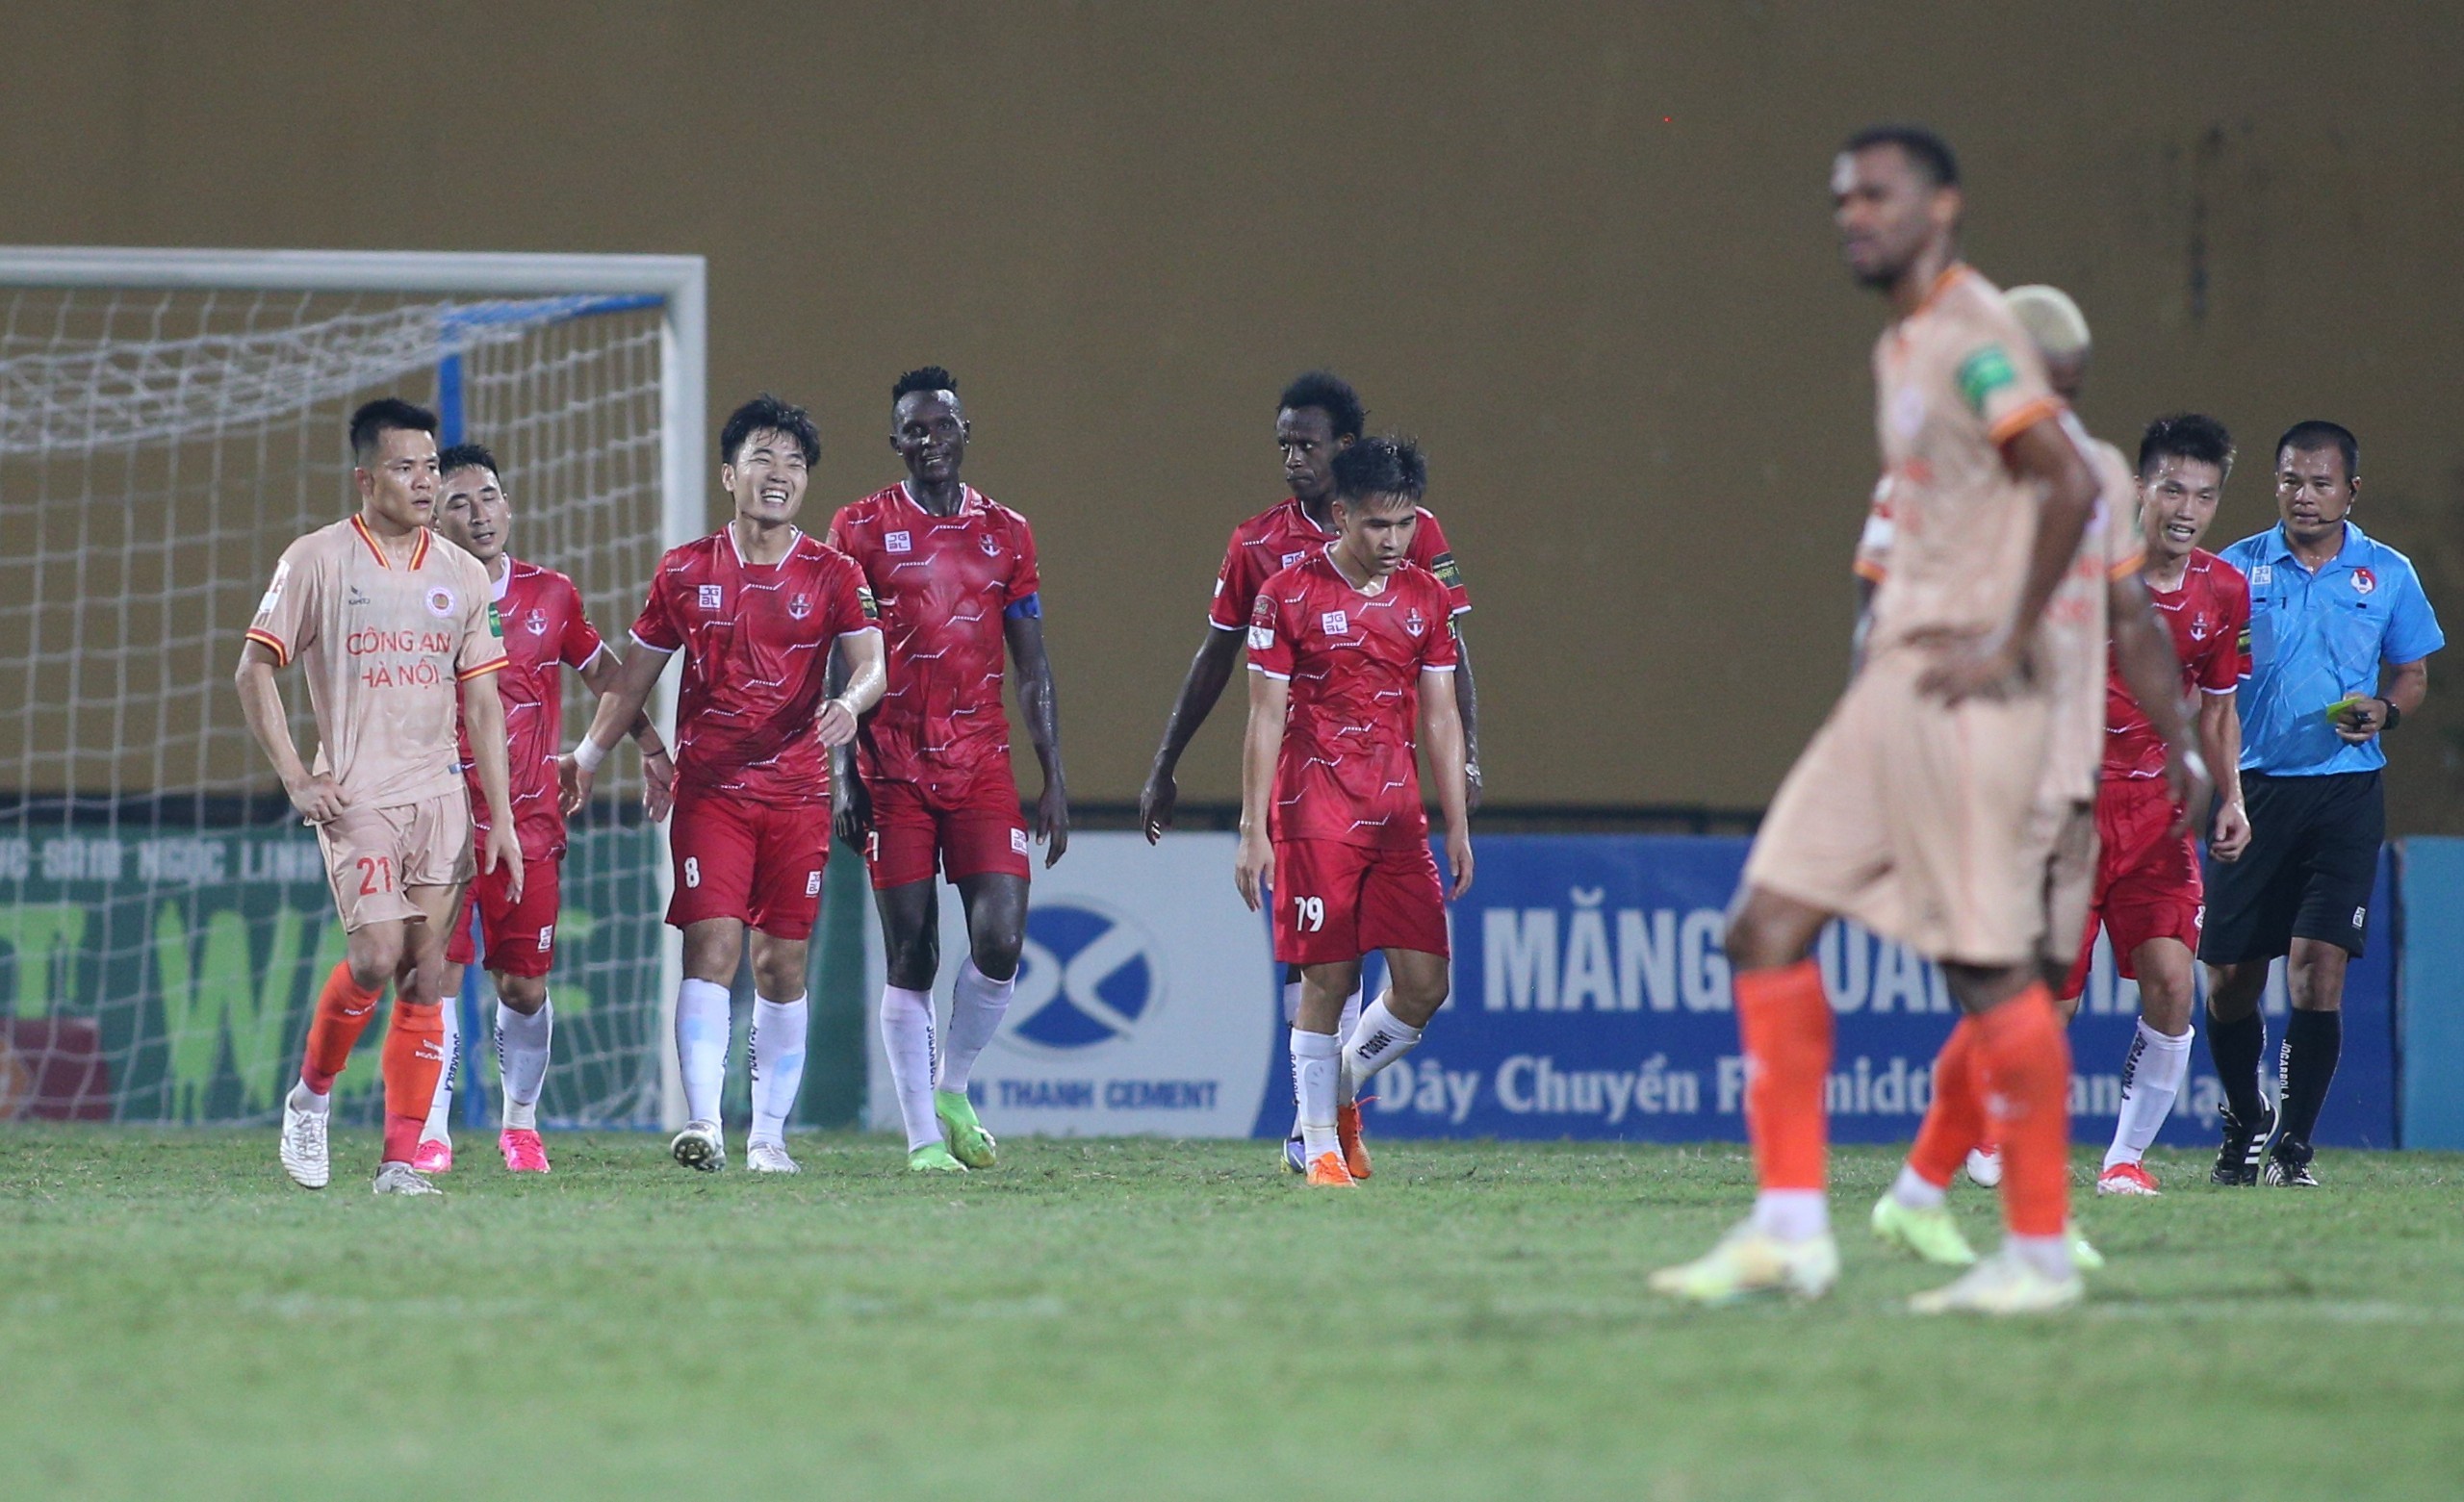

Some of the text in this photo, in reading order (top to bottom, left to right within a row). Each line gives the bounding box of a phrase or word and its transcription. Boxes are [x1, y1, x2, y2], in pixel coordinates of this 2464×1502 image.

[346, 625, 451, 655] CÔNG AN
[361, 657, 439, 689] HÀ NỘI
[356, 855, 393, 896] 21
[683, 856, 701, 889] 8
[1294, 896, 1324, 932] 79
[1482, 885, 1732, 1011] MĂNG
[998, 1079, 1093, 1107] THANH
[1107, 1079, 1218, 1109] CEMENT
